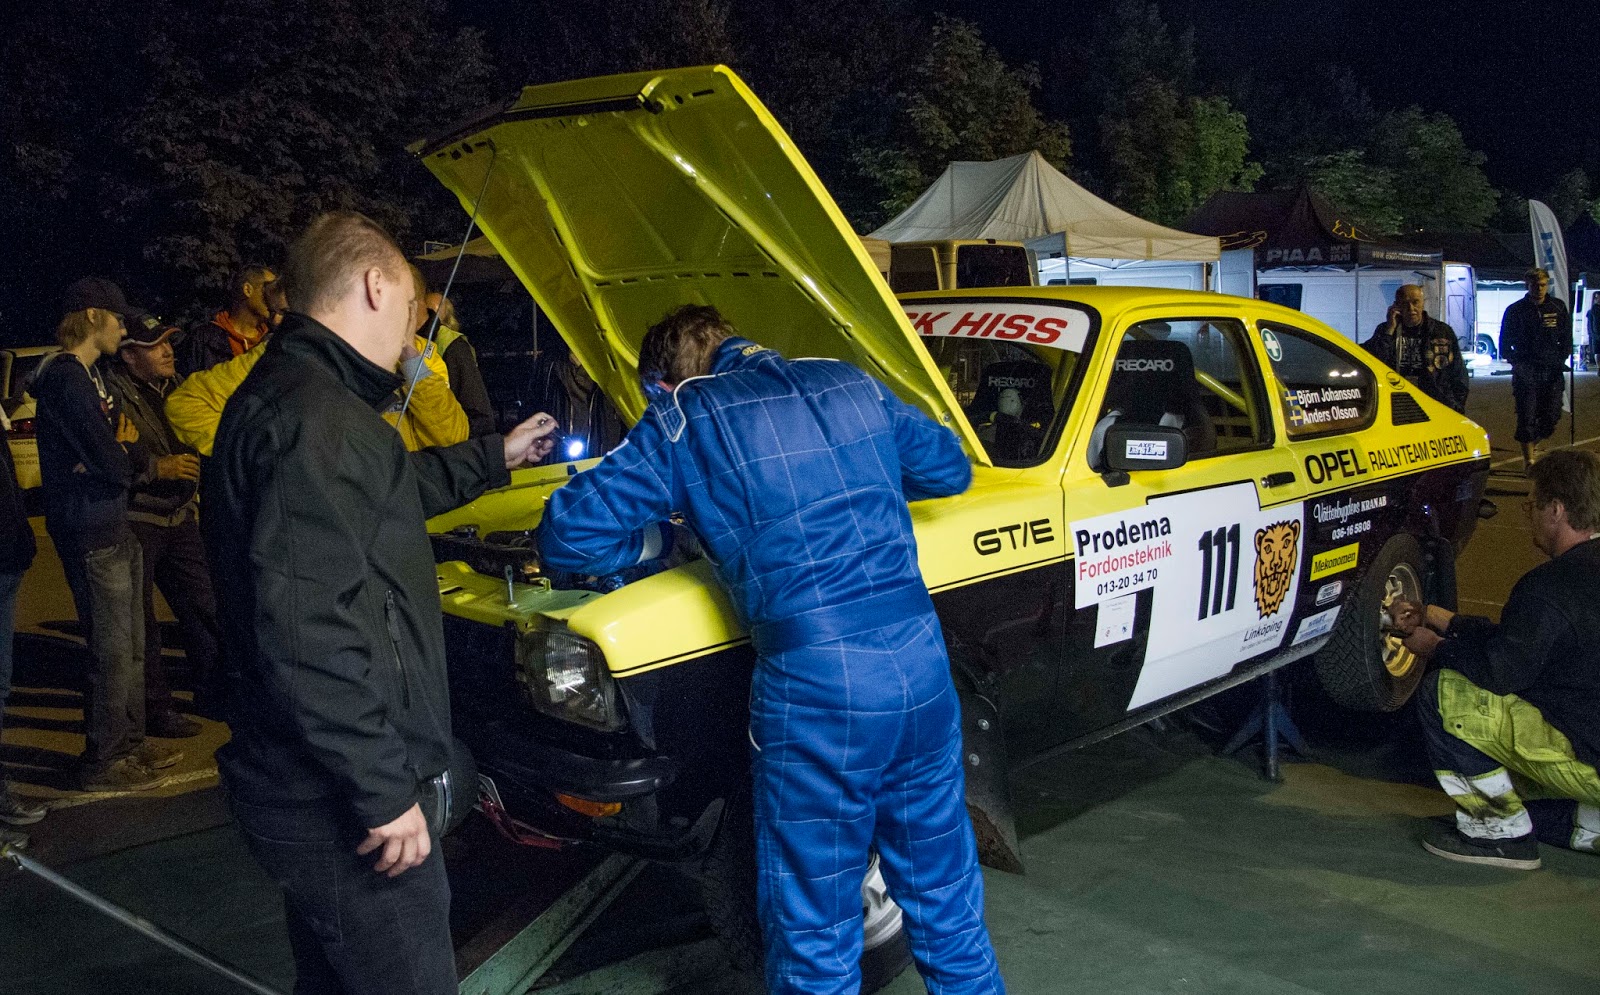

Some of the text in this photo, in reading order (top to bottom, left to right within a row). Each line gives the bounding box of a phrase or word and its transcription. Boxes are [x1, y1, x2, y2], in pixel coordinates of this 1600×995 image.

[1266, 247, 1323, 262] PIAA
[948, 312, 1068, 345] HISS
[1115, 359, 1174, 372] RECARO
[988, 375, 1037, 388] RECARO
[1296, 387, 1362, 408] Björn Johansson
[1303, 405, 1359, 425] Anders Olsson
[1304, 448, 1368, 485] OPEL
[1429, 434, 1468, 459] SWEDEN
[973, 518, 1055, 556] GT/E
[1075, 516, 1172, 557] Prodema
[1079, 540, 1173, 581] Fordonsteknik
[1198, 523, 1240, 621] 111
[1313, 552, 1356, 574] Mekonomen
[1097, 568, 1158, 596] 013-20 34 70
[1243, 619, 1283, 642] Linköping
